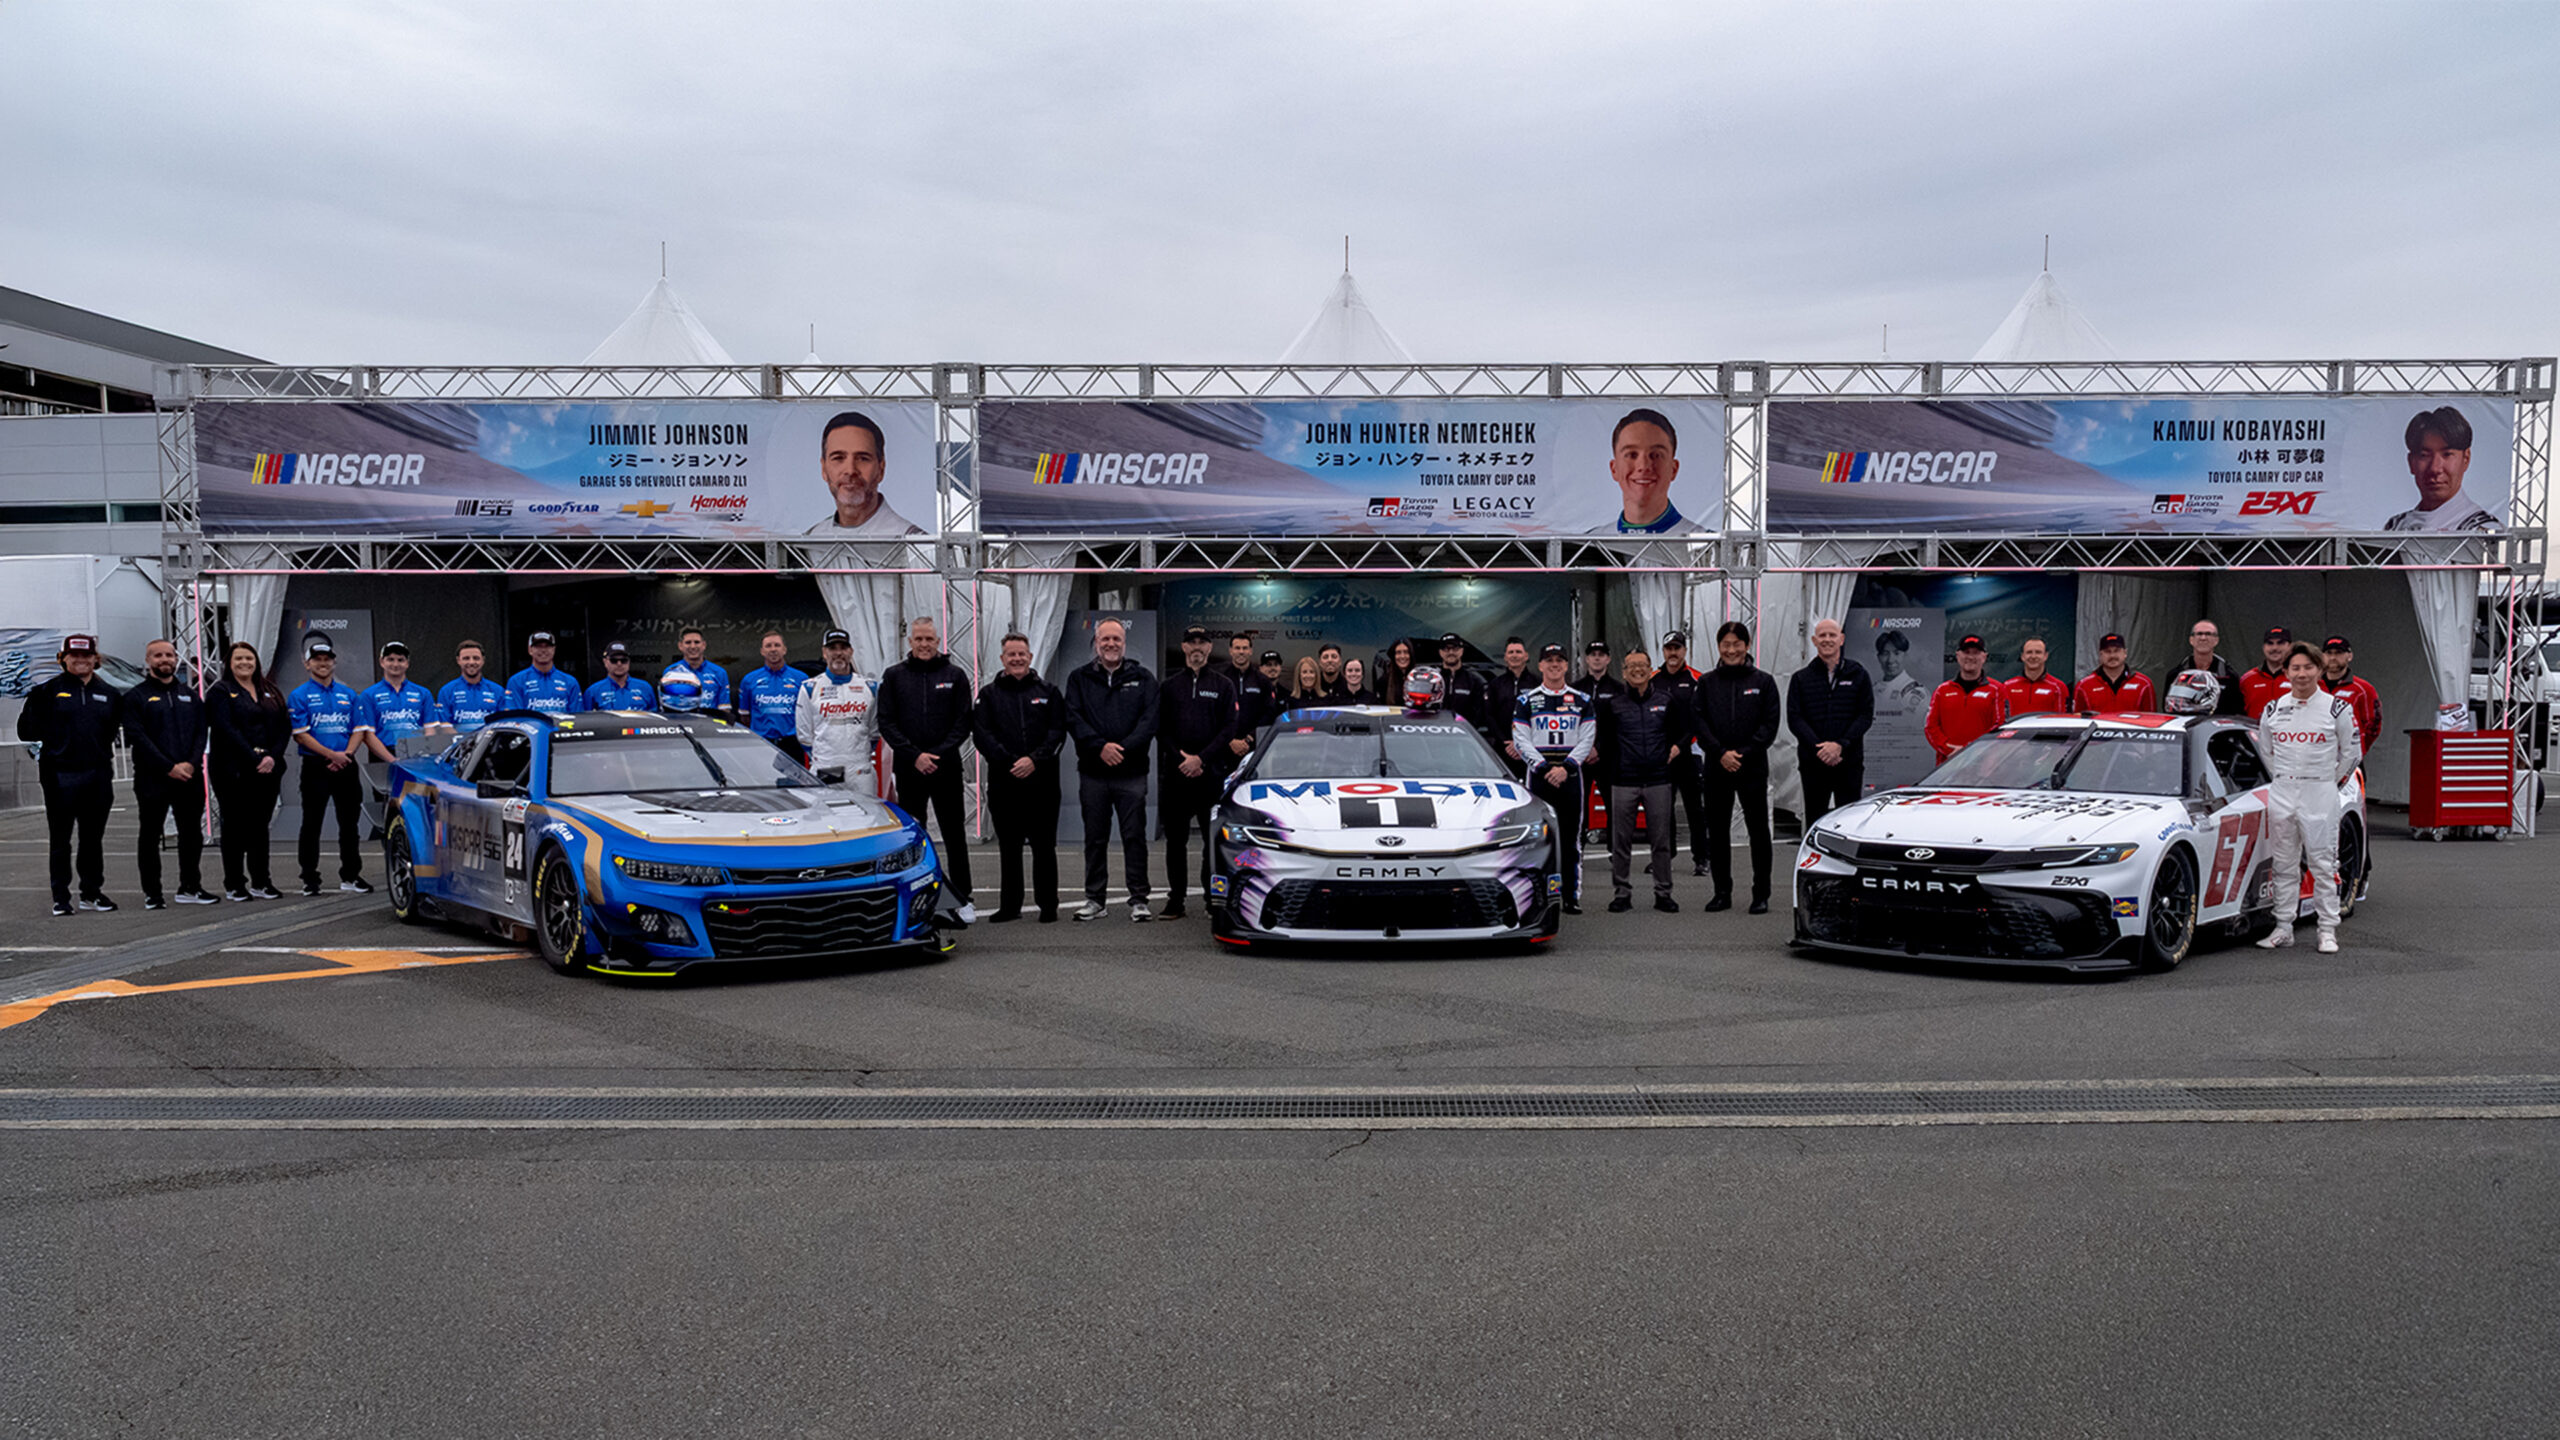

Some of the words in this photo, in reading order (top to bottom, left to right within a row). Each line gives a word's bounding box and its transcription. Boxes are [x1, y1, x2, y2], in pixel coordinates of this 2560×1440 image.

[589, 424, 656, 446] JIMMIE
[664, 424, 748, 446] JOHNSON
[1306, 423, 1351, 444] JOHN
[1359, 423, 1429, 444] HUNTER
[1437, 423, 1536, 444] NEMECHEK
[2153, 420, 2215, 441] KAMUI
[2223, 420, 2325, 441] KOBAYASHI
[609, 453, 748, 468] ジミー・ジョンソン
[1315, 451, 1535, 467] ジョン・ハンター・ネメチェク
[2238, 449, 2270, 464] 小林
[2277, 449, 2325, 464] 可夢偉
[294, 453, 426, 485] NASCAR
[1076, 453, 1210, 484] NASCAR
[1863, 451, 1998, 483] NASCAR
[579, 475, 616, 488] GARAGE
[619, 475, 632, 488] 56
[635, 475, 686, 488] CHEVROLET
[689, 475, 730, 488] CAMARO
[732, 475, 748, 488] ZL1
[1420, 474, 1454, 486] TOYOTA
[1457, 474, 1491, 486] CAMRY
[1495, 474, 1514, 486] CUP
[1516, 474, 1536, 486] CAR
[2208, 471, 2242, 483] TOYOTA
[2245, 471, 2279, 483] CAMRY
[2282, 471, 2301, 483] CUP
[2304, 471, 2324, 483] CAR
[528, 501, 599, 514] GOODYEAR
[690, 494, 749, 512] Hendrick
[1453, 497, 1536, 510] LEGACY
[2151, 502, 2183, 514] GR
[479, 505, 513, 516] 56
[1367, 504, 1397, 517] GR
[309, 619, 348, 629] NASCAR
[1882, 618, 1921, 628] NASCAR
[756, 694, 797, 707] Hendrick
[820, 701, 868, 717] Hendrick
[1390, 724, 1466, 735] TOYOTA
[1536, 717, 1577, 730] Mobil
[640, 727, 693, 736] NASCAR
[2092, 730, 2176, 741] OBAYASHI
[2273, 732, 2326, 743] TOYOTA
[1250, 781, 1517, 801] Mobil
[1367, 798, 1399, 825] 1
[484, 840, 501, 861] 56
[506, 831, 523, 870] 24
[2203, 810, 2262, 908] 67
[1336, 866, 1446, 878] CAMRY
[1862, 877, 1971, 894] CAMRY
